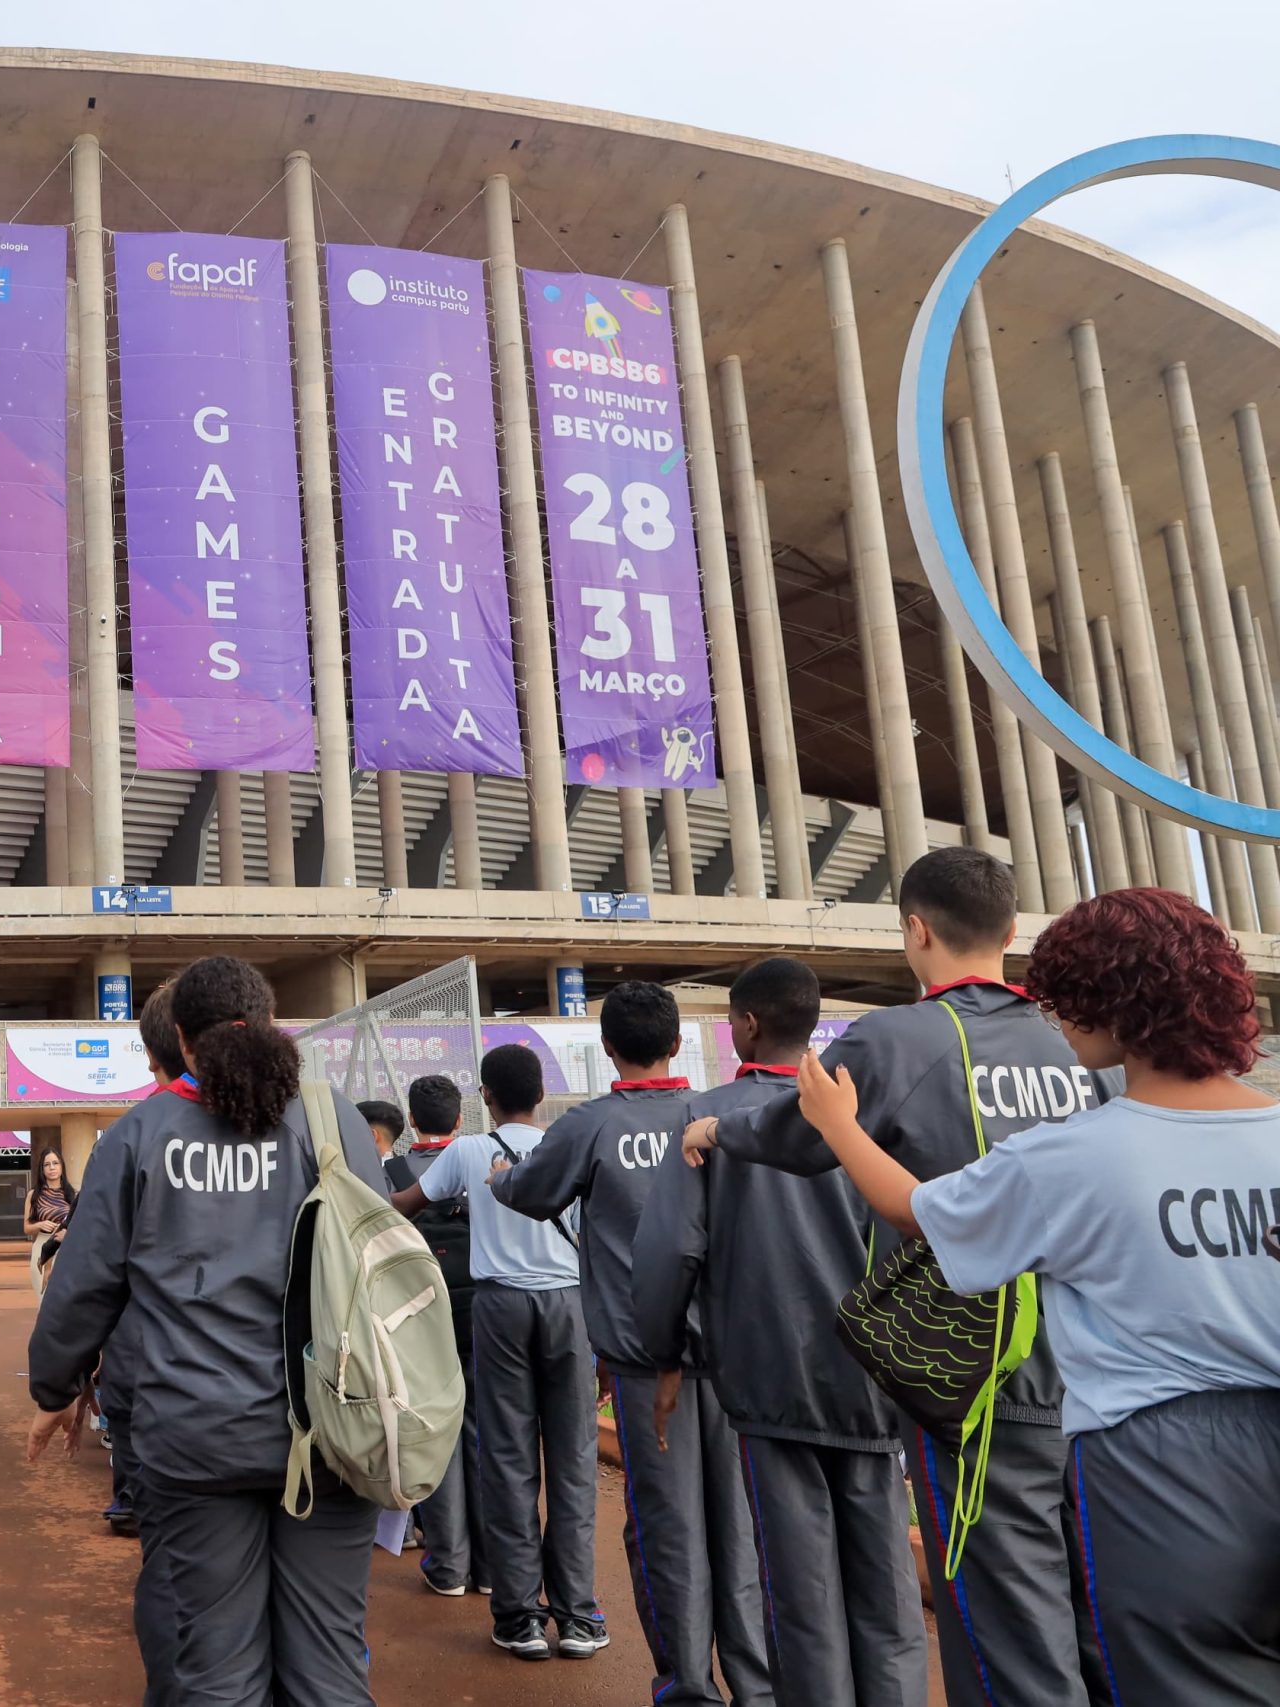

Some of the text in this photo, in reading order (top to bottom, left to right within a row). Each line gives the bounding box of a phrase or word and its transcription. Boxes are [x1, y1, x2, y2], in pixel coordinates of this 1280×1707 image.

[168, 253, 257, 291] fapdf
[389, 275, 468, 301] instituto
[391, 293, 470, 315] campus party
[552, 348, 661, 385] CPBSB6
[549, 383, 668, 415] TO INFINITY
[600, 409, 625, 421] AND
[552, 414, 673, 452] BEYOND
[562, 472, 676, 552] 28
[192, 406, 241, 681] GAMES
[382, 387, 432, 712] ENTRADA
[427, 372, 483, 742] GRATUITA
[615, 558, 638, 580] A
[579, 586, 676, 663] 31
[579, 669, 686, 701] MARÇO
[100, 890, 128, 908] 14
[588, 896, 612, 914] 15
[565, 1002, 587, 1017] 15
[88, 1072, 117, 1080] SEBRAE
[972, 1065, 1093, 1119] CCMDF
[164, 1138, 278, 1193] CCMDF
[617, 1131, 673, 1170] CCM
[1158, 1187, 1280, 1259] CCM
